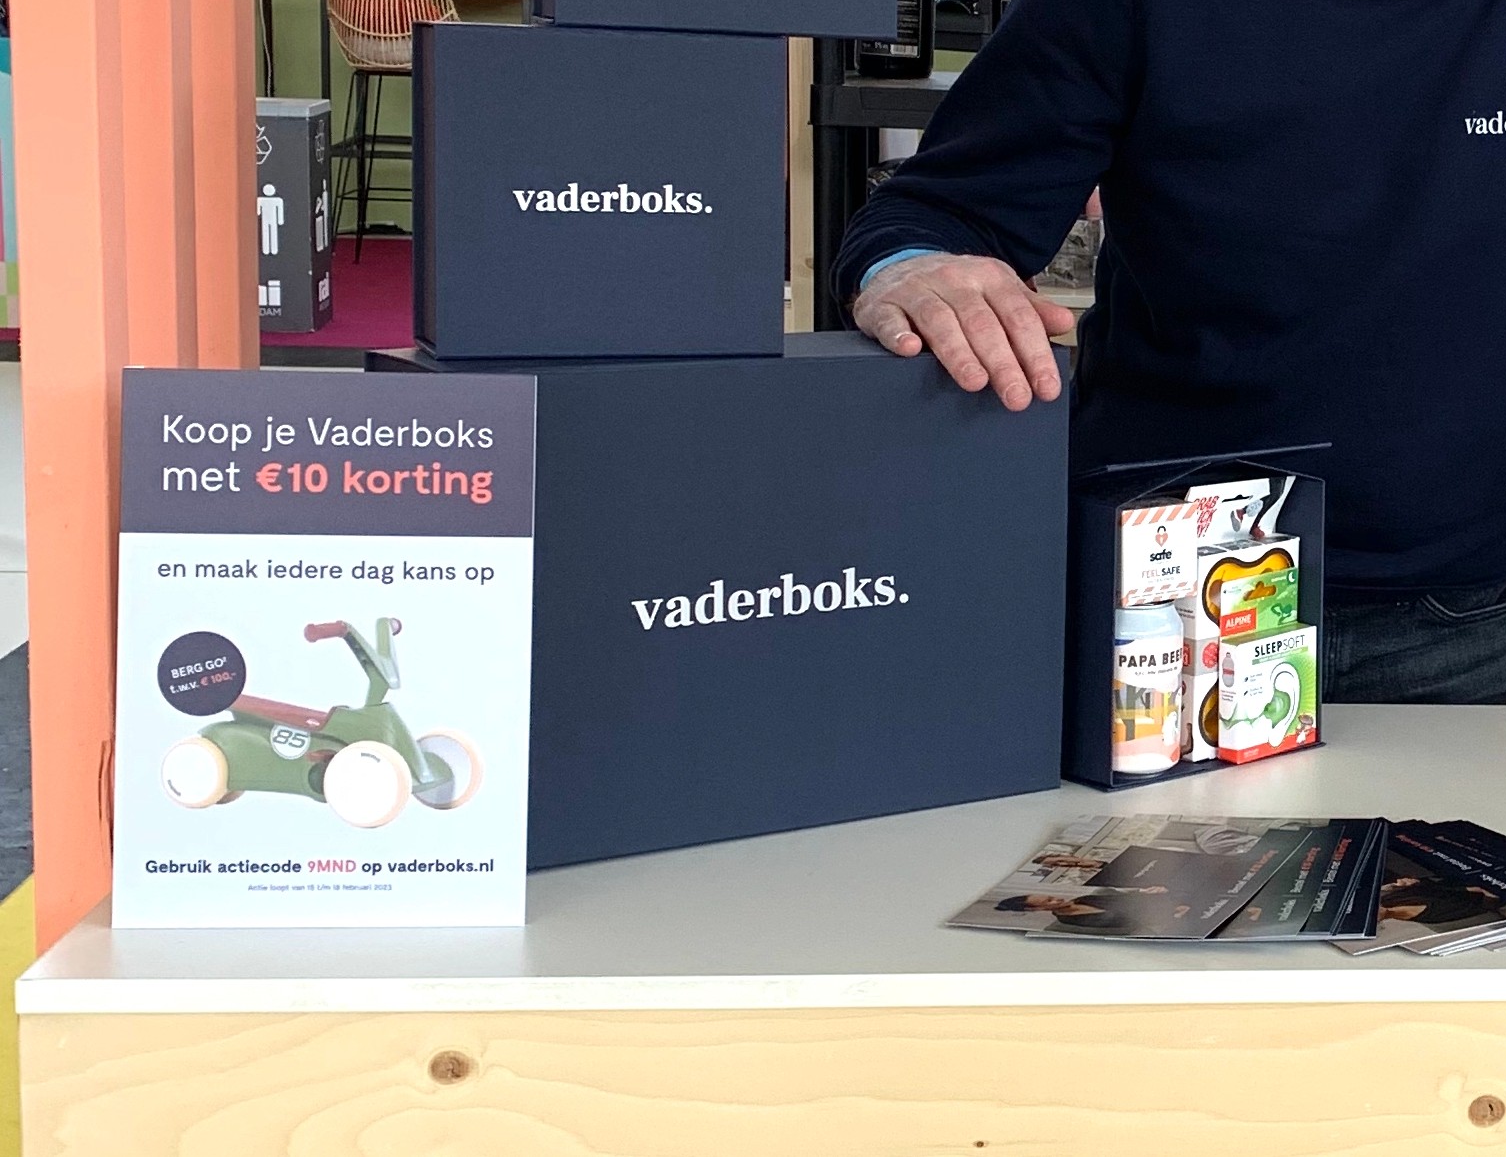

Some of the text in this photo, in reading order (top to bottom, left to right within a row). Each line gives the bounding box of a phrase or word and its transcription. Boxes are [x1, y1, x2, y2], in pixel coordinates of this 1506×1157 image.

[513, 182, 713, 214] vaderboks.
[162, 414, 494, 452] Koop je Vaderboks
[162, 462, 494, 504] met €10 korting
[1150, 548, 1172, 562] safe
[157, 559, 495, 587] en maak iedere dag kans op
[1161, 566, 1181, 576] SAFE
[631, 567, 909, 630] vaderboks.
[1225, 613, 1252, 629] ALPINE
[1119, 654, 1157, 668] PAPA
[171, 663, 203, 679] BERG
[170, 682, 199, 694] t.w.v.
[272, 729, 309, 749] 85
[145, 858, 494, 876] Gebruik actiecode 9MND op vaderboks.nl
